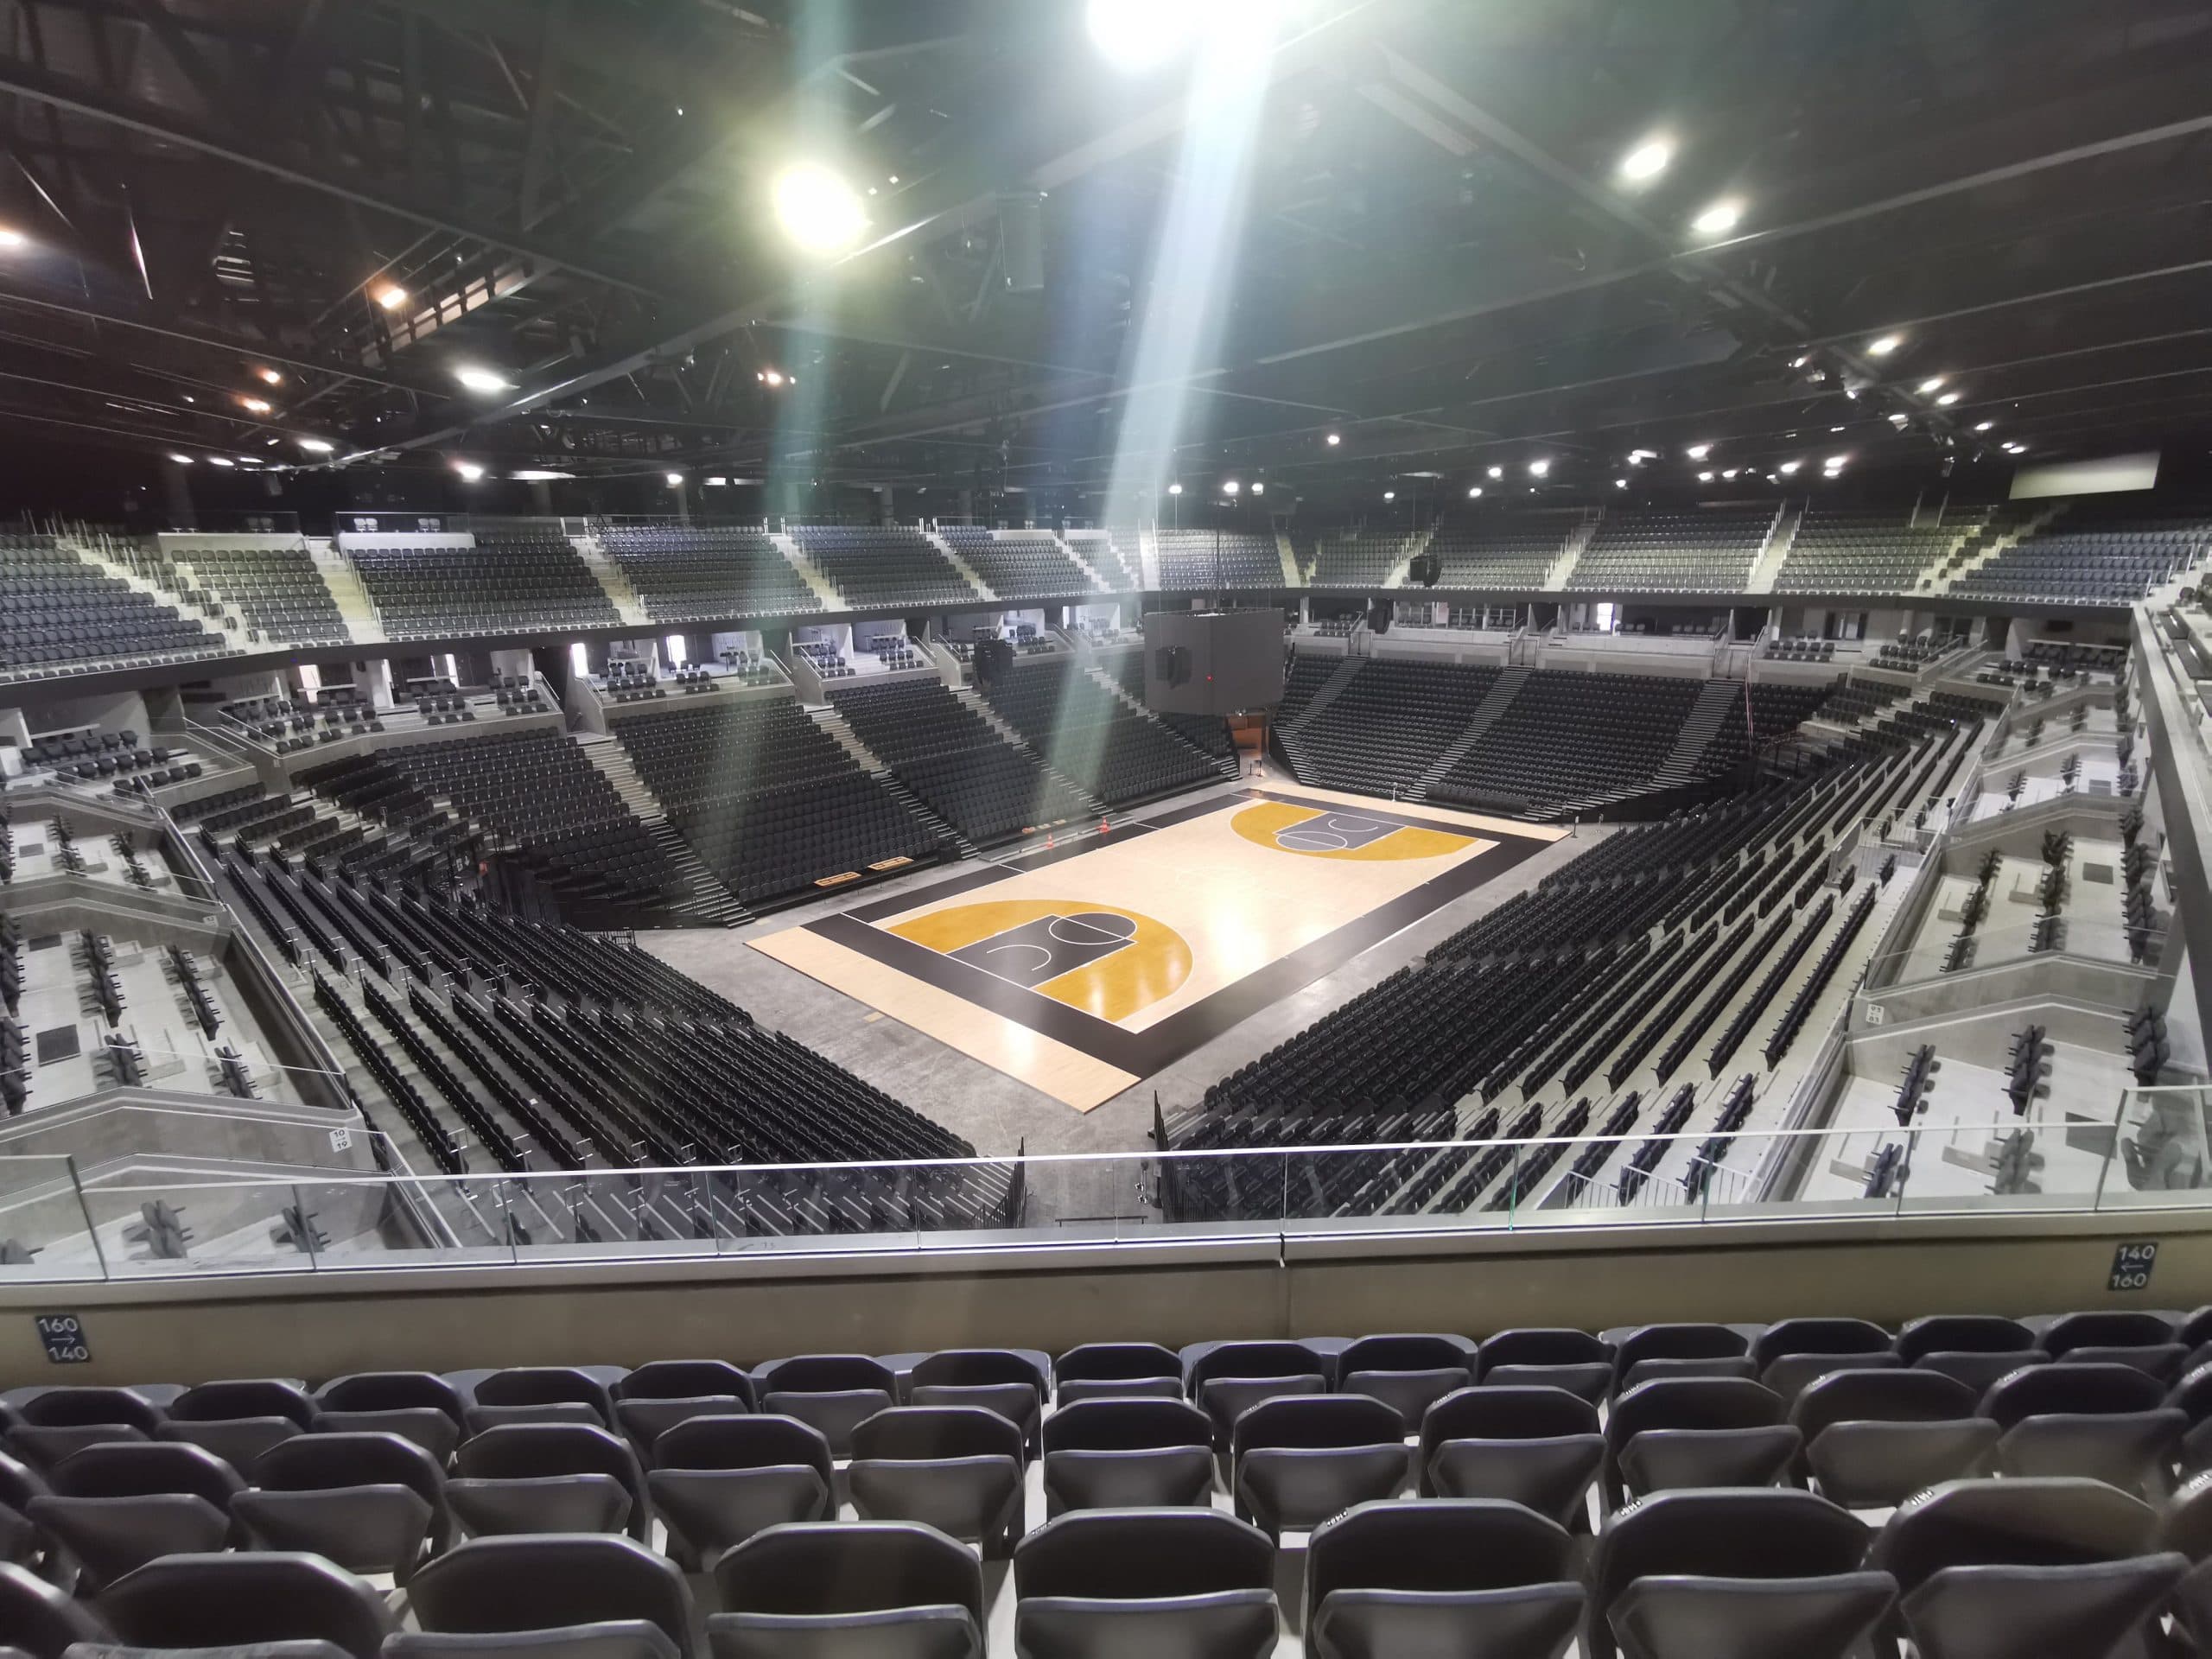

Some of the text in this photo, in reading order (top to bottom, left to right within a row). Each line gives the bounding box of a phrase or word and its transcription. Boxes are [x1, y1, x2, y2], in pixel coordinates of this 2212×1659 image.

[336, 1141, 347, 1149] 19
[2120, 1245, 2155, 1261] 140
[2112, 1273, 2147, 1287] 160
[38, 1318, 79, 1332] 160
[48, 1346, 88, 1361] 140
